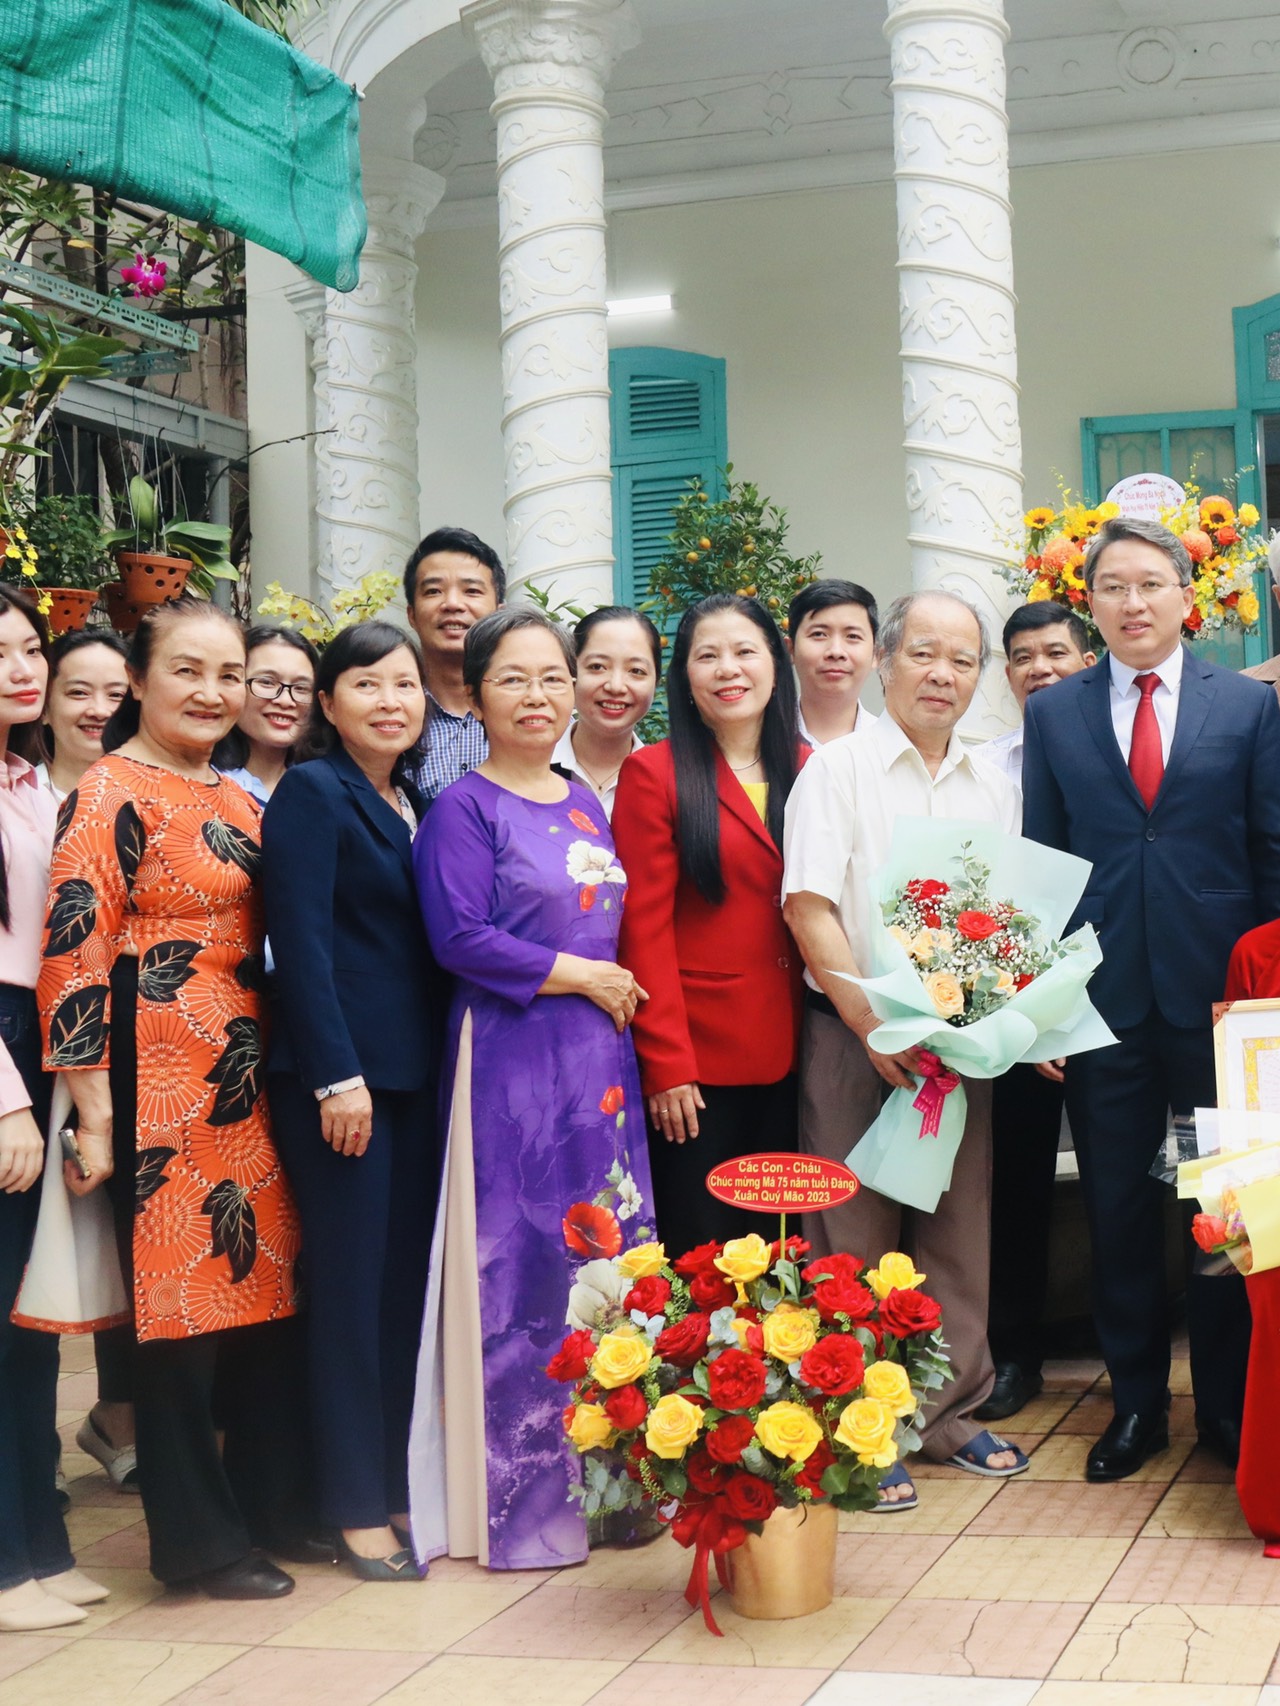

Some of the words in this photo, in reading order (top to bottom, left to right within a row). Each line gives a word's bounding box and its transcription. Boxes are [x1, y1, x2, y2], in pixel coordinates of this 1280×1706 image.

[738, 1160, 759, 1173] Các
[761, 1161, 783, 1173] Con
[793, 1161, 821, 1174] Cháu
[710, 1175, 733, 1187] Chúc
[734, 1176, 760, 1189] mừng
[762, 1176, 775, 1188] Má
[777, 1176, 788, 1188] 75
[790, 1177, 809, 1188] năm
[811, 1174, 829, 1189] tuổi
[831, 1177, 855, 1193] Đảng
[733, 1189, 759, 1201] Xuân
[761, 1190, 781, 1204] Quý
[783, 1190, 804, 1202] Mão
[807, 1191, 831, 1203] 2023
